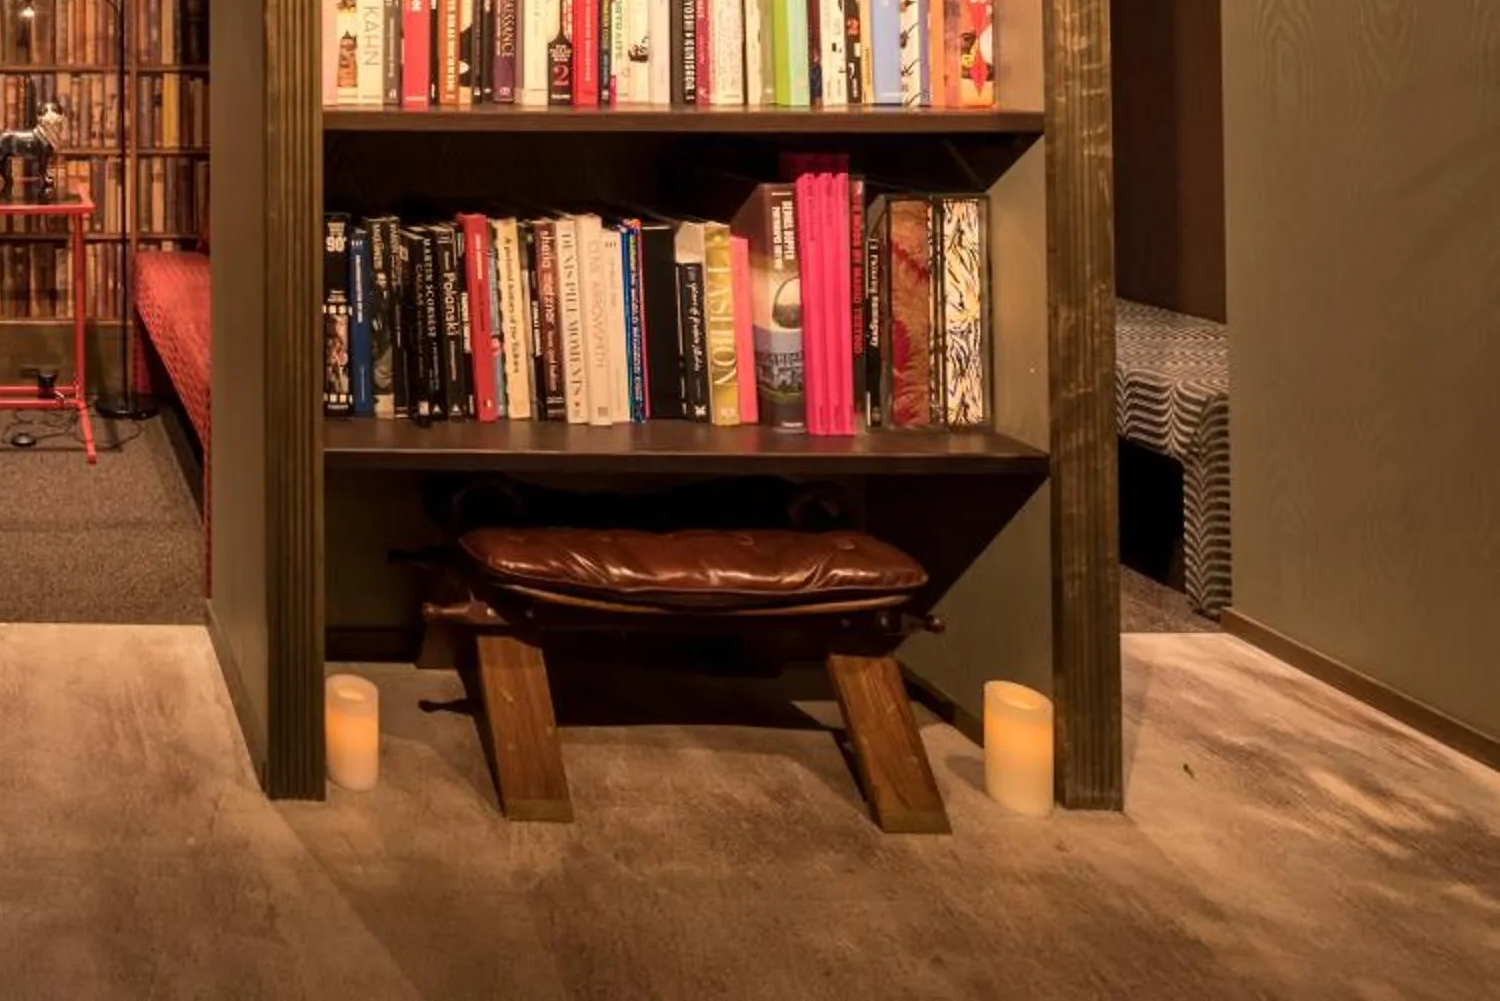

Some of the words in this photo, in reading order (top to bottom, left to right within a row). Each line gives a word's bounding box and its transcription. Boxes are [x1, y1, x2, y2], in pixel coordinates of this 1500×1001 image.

[363, 6, 381, 66] KAHN
[423, 239, 433, 281] MARTIN
[443, 272, 460, 336] Polanski
[708, 266, 737, 386] FASHION
[567, 320, 581, 396] MOMENTS
